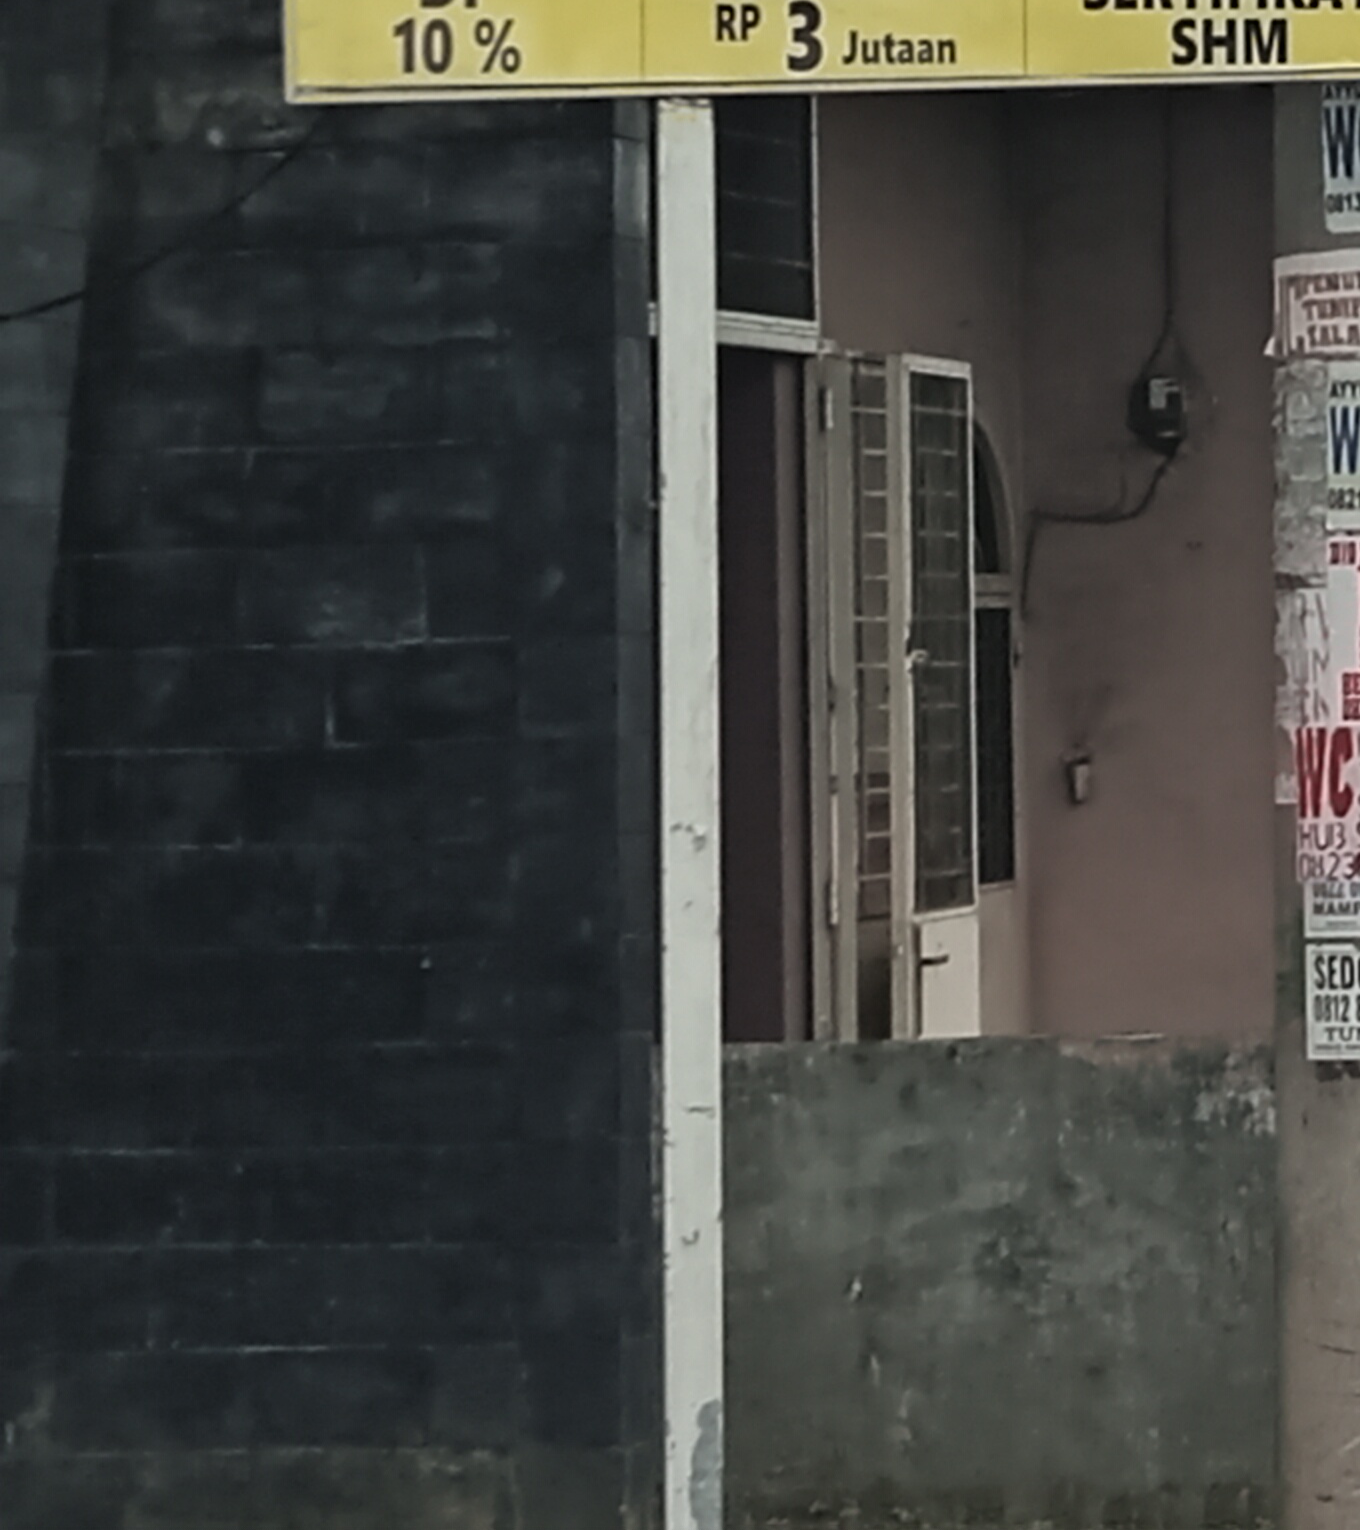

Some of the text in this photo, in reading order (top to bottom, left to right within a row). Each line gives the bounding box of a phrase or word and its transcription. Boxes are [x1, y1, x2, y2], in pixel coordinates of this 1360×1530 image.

[392, 19, 522, 75] 10 %
[714, 6, 762, 44] RP
[840, 30, 957, 69] Jutaan
[1169, 17, 1291, 69] SHM
[1296, 726, 1354, 819] WC
[1299, 823, 1347, 851] HUB
